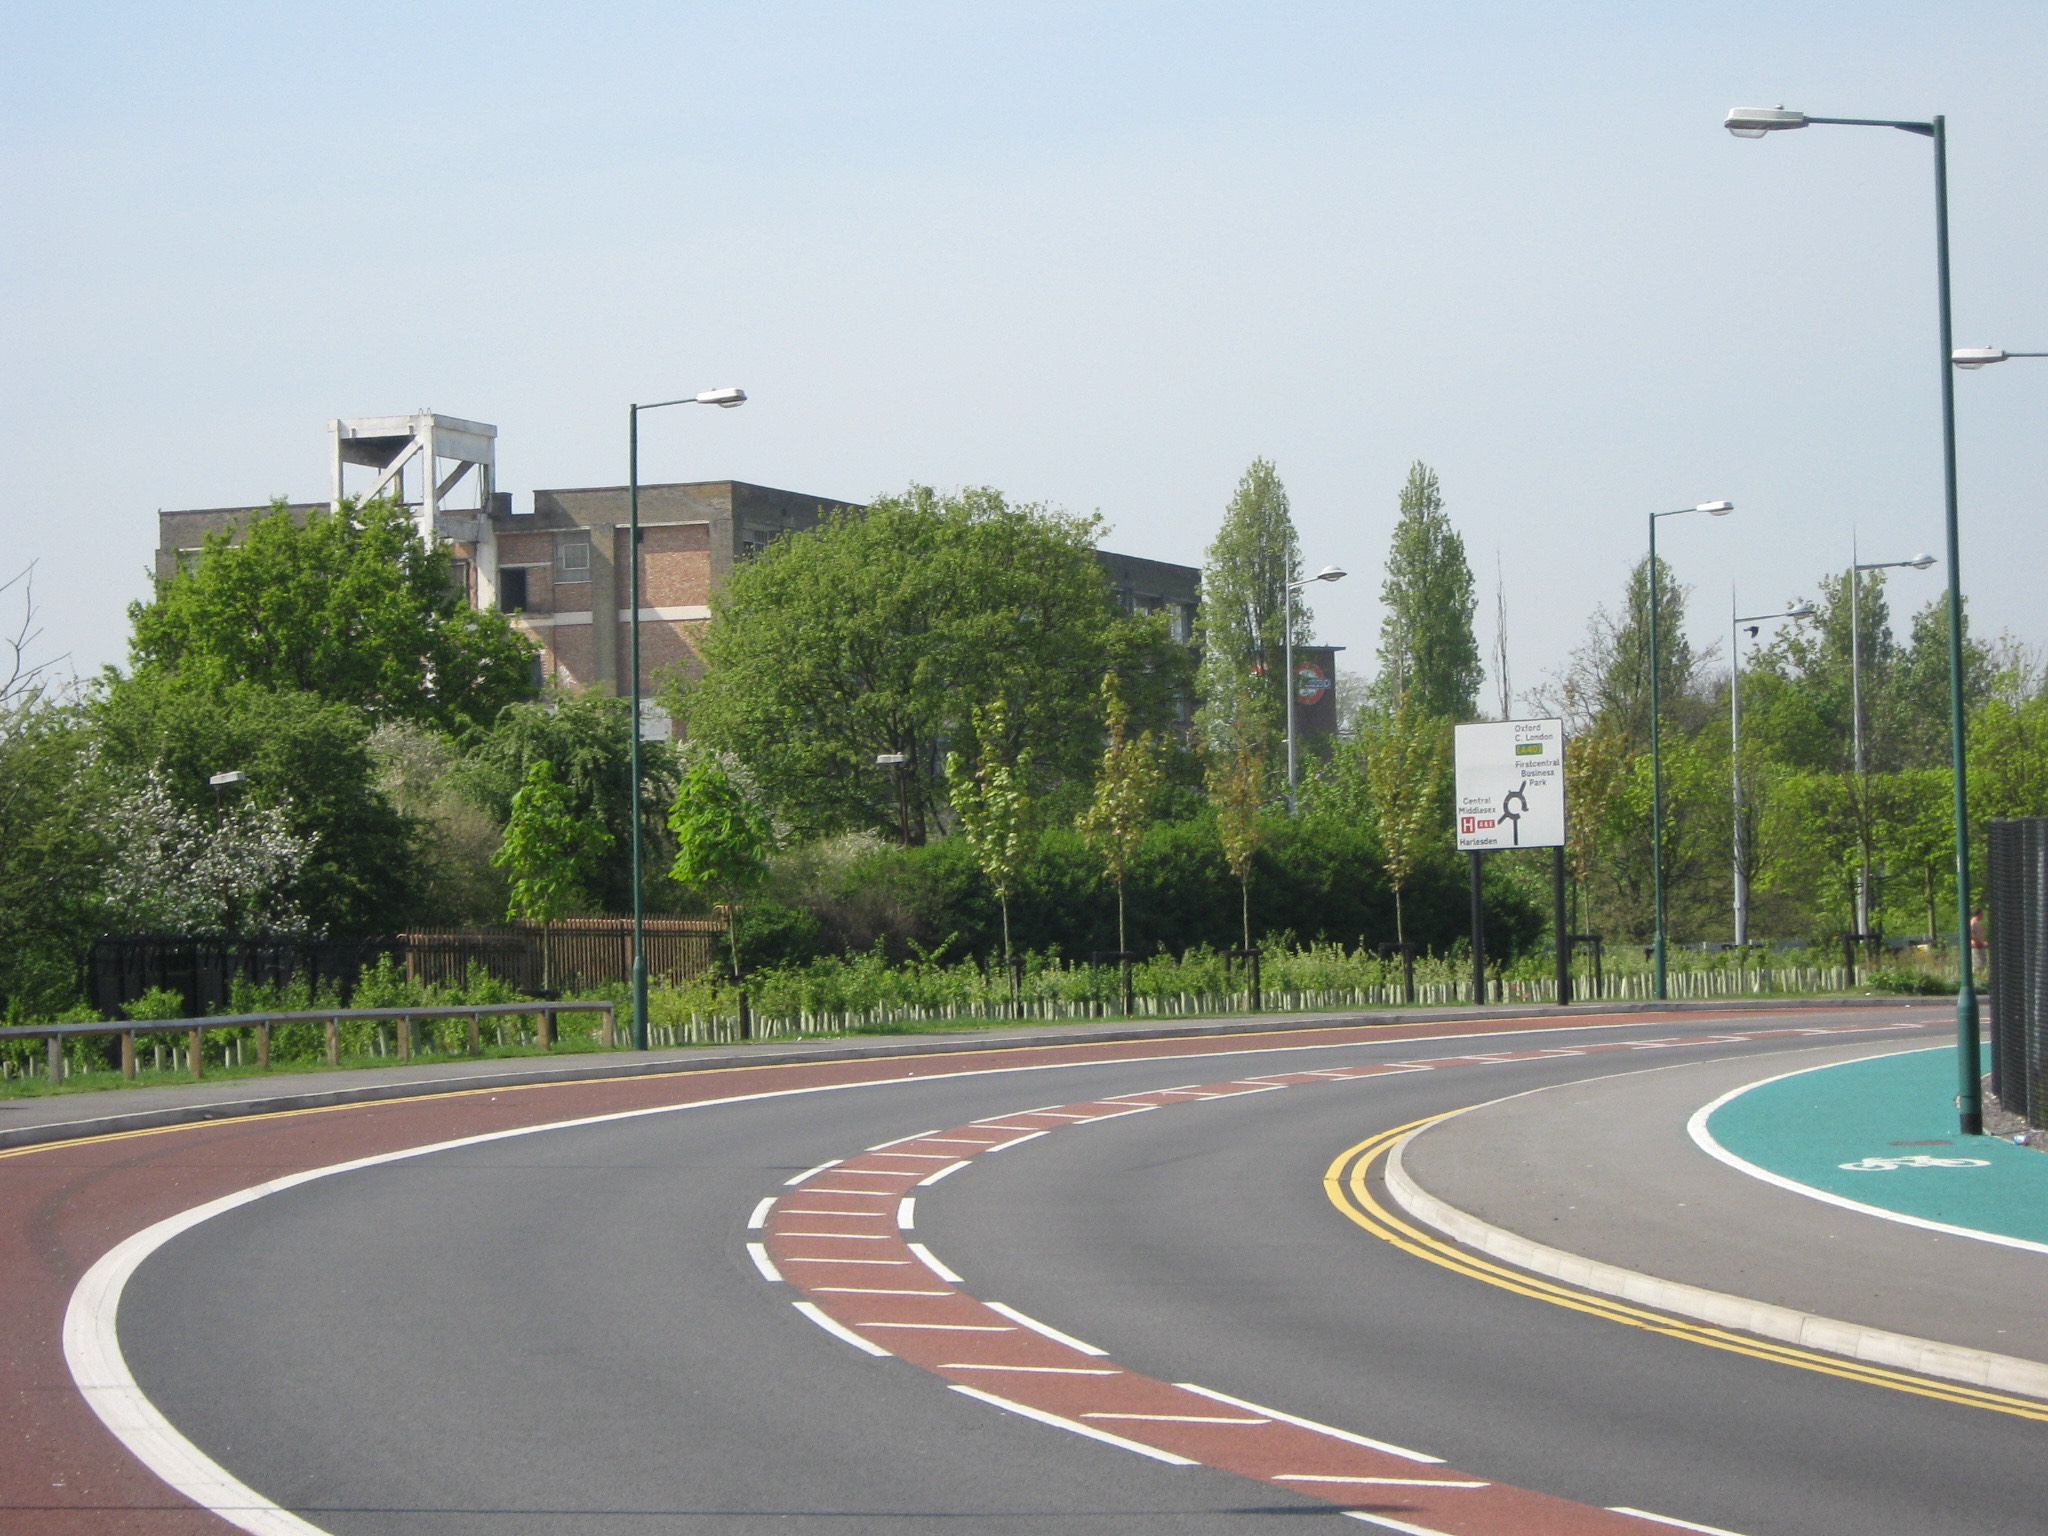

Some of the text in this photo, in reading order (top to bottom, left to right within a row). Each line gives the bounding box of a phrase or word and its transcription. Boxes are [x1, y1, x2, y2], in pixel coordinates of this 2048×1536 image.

[1514, 724, 1541, 732] Oxford
[1514, 733, 1553, 742] C. London
[1515, 758, 1560, 768] Firstcentral
[1521, 769, 1555, 777] Business
[1463, 797, 1491, 805] Central
[1458, 806, 1496, 814] Middlesex
[1463, 818, 1494, 832] H A&E
[1460, 837, 1497, 846] Harlesden
